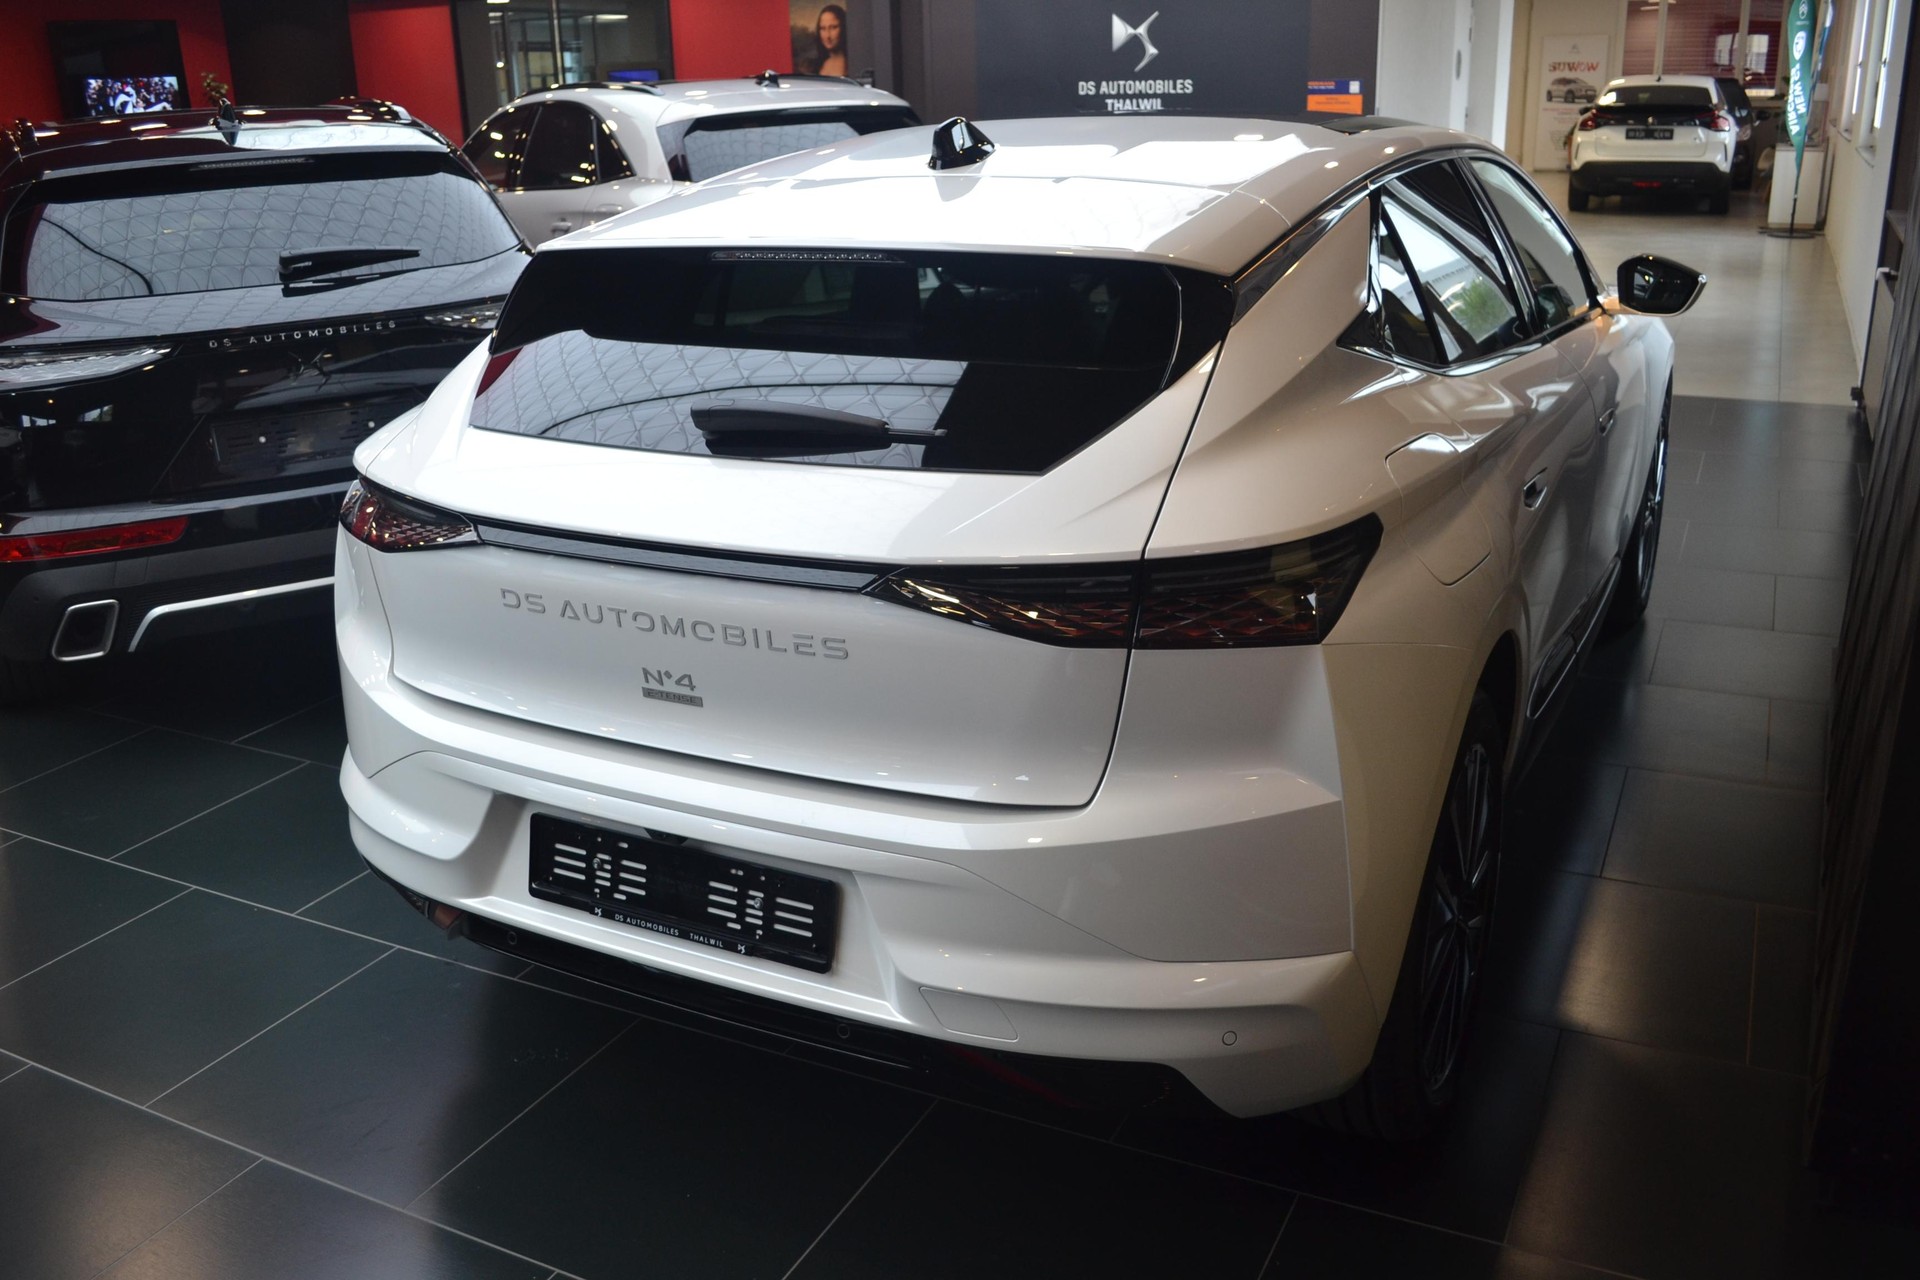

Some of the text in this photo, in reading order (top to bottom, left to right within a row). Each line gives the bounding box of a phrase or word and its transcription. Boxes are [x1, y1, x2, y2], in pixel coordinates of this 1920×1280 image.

[1078, 79, 1194, 95] DS AUTOMOBILES
[1105, 98, 1164, 111] THALWIL
[209, 320, 396, 349] DS AUTOMOBILES
[500, 588, 849, 660] DS AUTOMOBILES
[614, 913, 724, 948] DS AUTOMOBILES THALWIL
